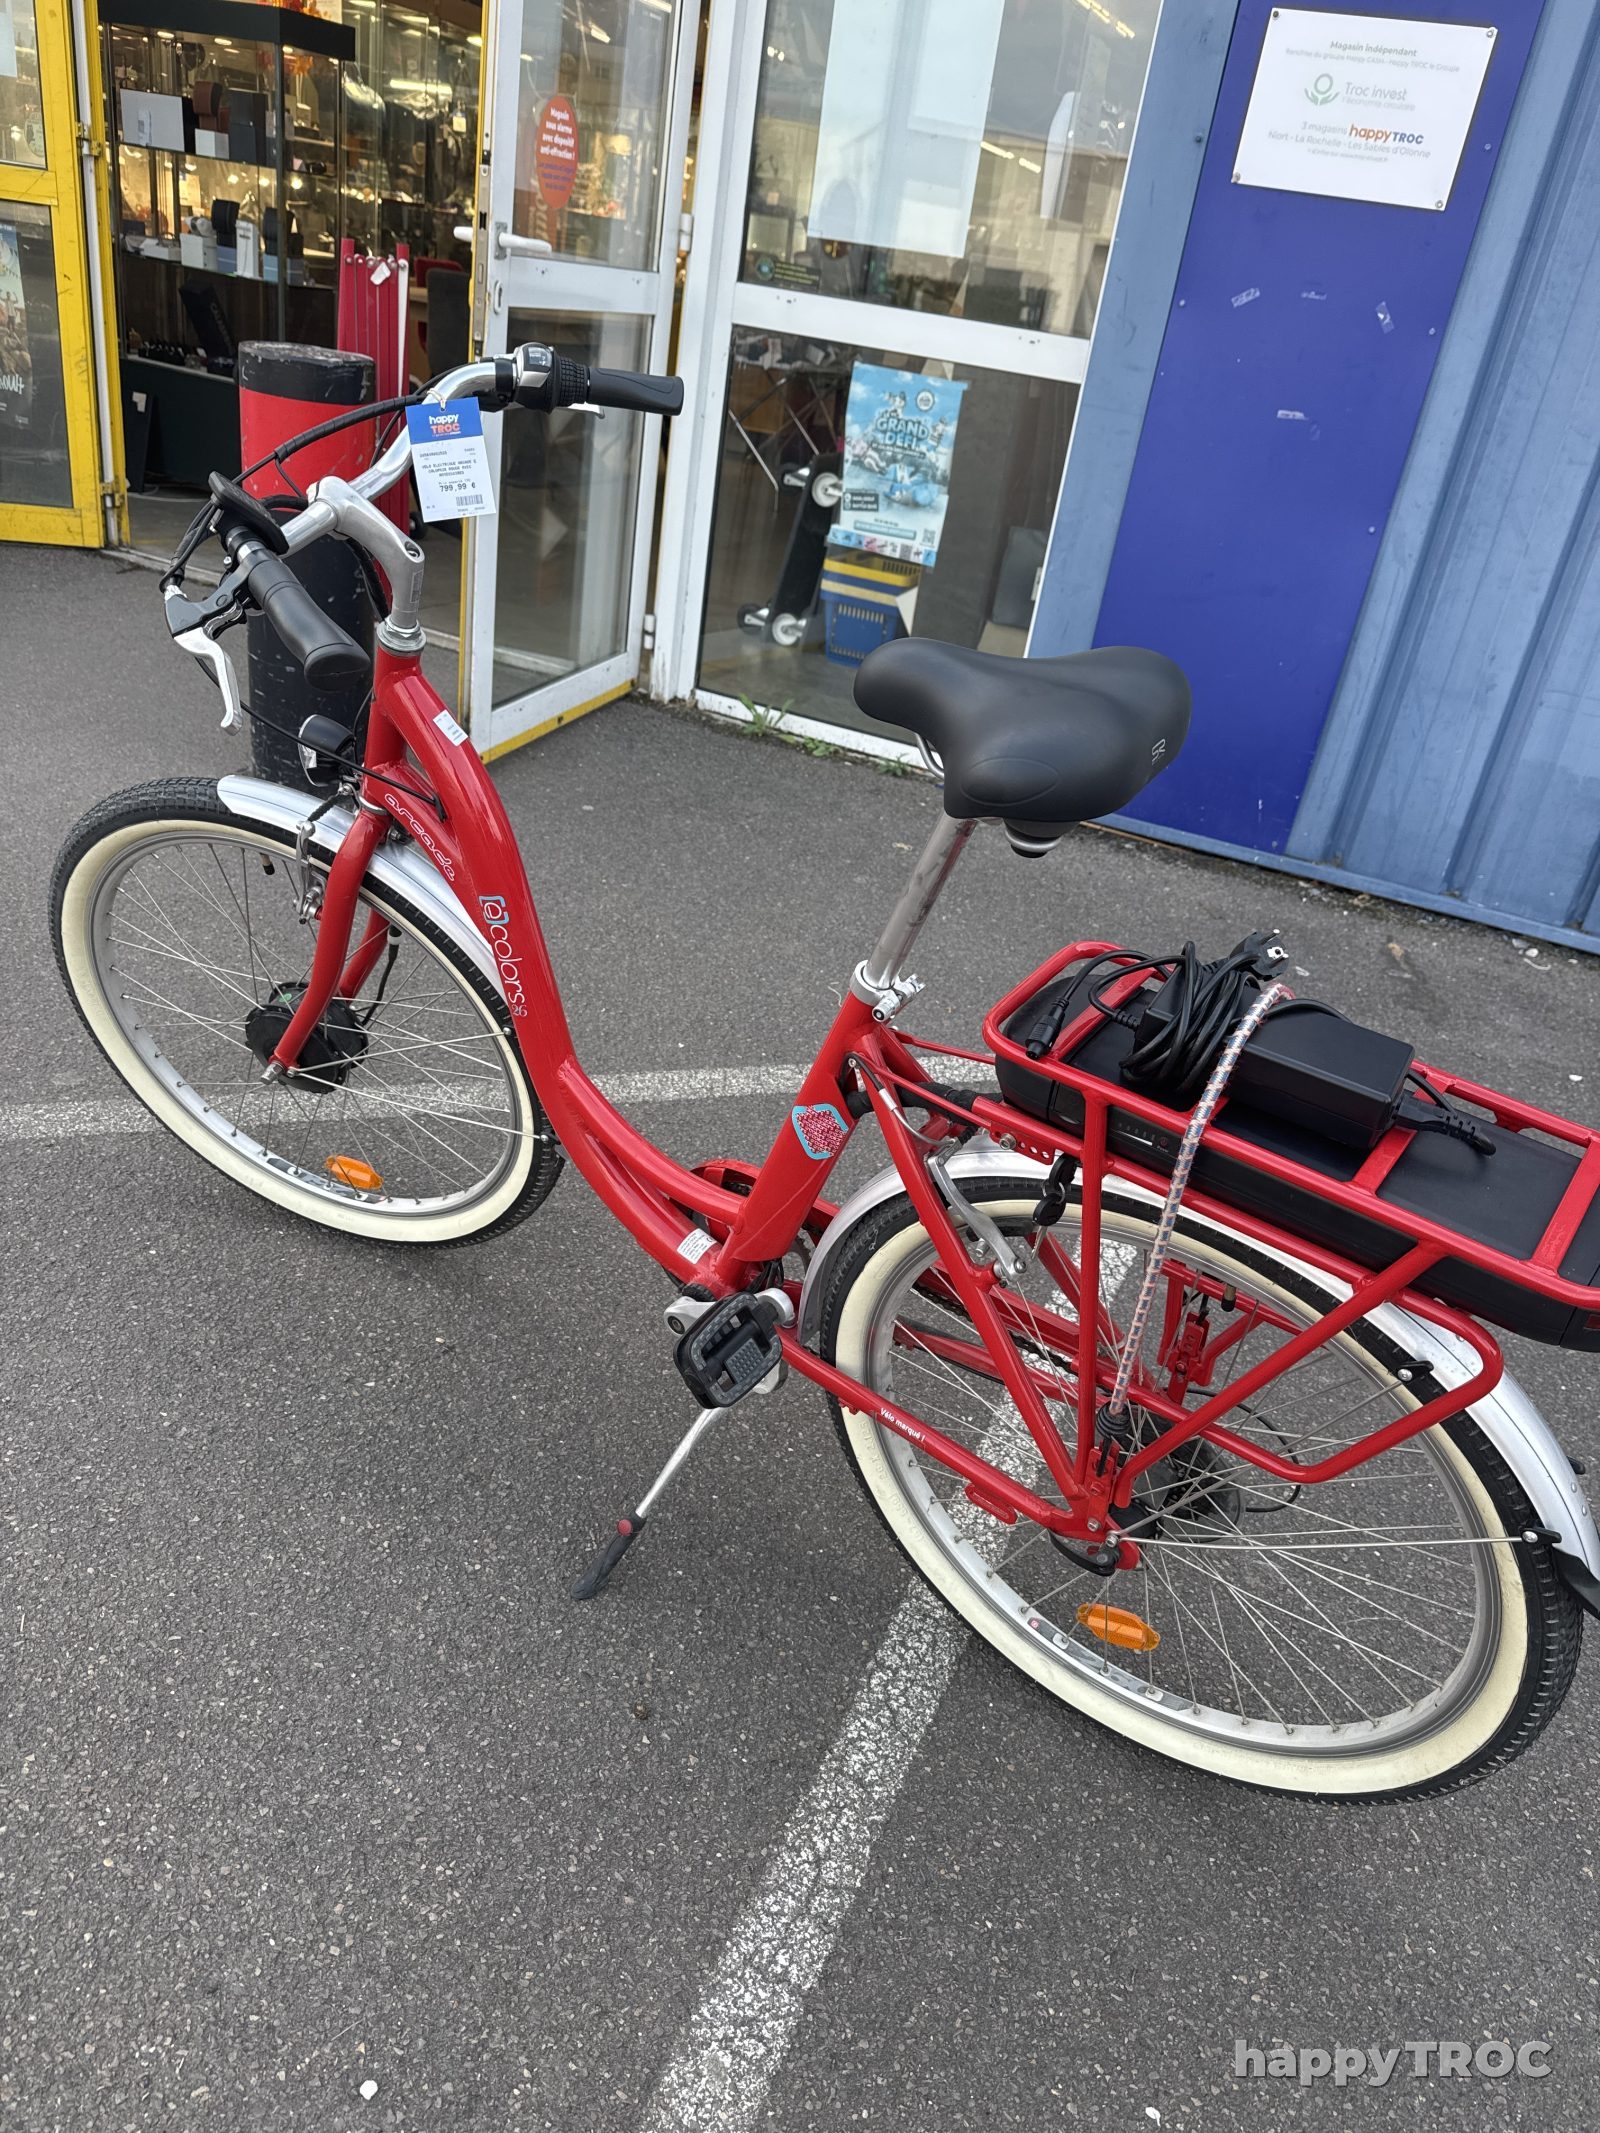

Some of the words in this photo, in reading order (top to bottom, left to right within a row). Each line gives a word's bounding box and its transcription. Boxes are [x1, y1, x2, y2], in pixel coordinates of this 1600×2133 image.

[1330, 40, 1363, 52] Magasin
[1365, 43, 1417, 57] indépendant
[1345, 81, 1370, 97] Troc
[1371, 84, 1407, 101] invest
[429, 414, 459, 425] happy
[431, 423, 460, 434] TROC
[876, 418, 929, 439] GRAND
[439, 483, 467, 492] 799,99
[384, 792, 455, 882] arcade
[511, 1004, 528, 1018] 26
[880, 1407, 895, 1423] Vélo
[895, 1418, 921, 1437] marqué
